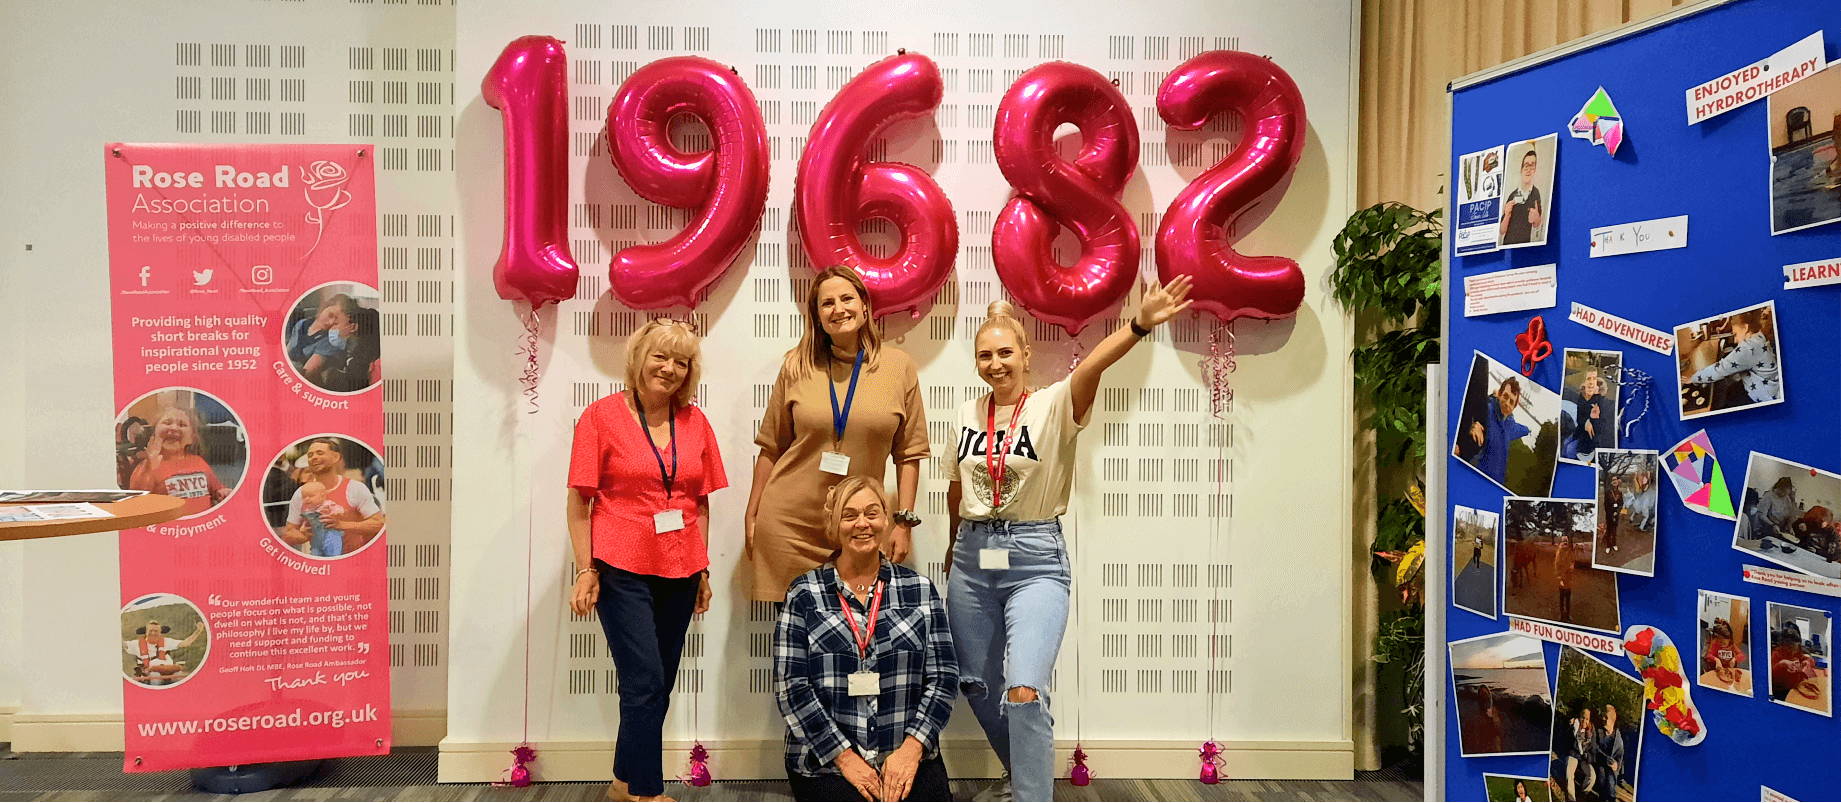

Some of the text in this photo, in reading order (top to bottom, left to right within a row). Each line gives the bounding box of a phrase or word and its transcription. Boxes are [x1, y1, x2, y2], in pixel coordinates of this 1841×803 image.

[1694, 65, 1761, 102] ENJOYED
[1695, 56, 1818, 119] HYRDROTHERAPY
[133, 165, 289, 188] Rose Road
[132, 193, 269, 213] Association
[1469, 200, 1492, 213] PACIP
[132, 221, 168, 232] Making
[180, 220, 217, 231] positive
[220, 219, 270, 229] difference
[273, 221, 284, 229] to
[133, 233, 296, 244] the lives of young disabled people
[1594, 230, 1625, 252] THAK
[1792, 263, 1841, 282] LEARN
[131, 314, 268, 329] Providing high quality
[1575, 307, 1671, 351] HAD ADVENTURES
[151, 329, 250, 342] short breaks for
[141, 345, 261, 359] inspirational young
[145, 359, 257, 375] people since 1952
[272, 361, 349, 410] Care & support
[957, 425, 1039, 467] UCLA
[177, 477, 206, 491] NYC
[146, 514, 227, 538] & enjoyment
[259, 537, 331, 576] Get involved!
[241, 596, 288, 607] wonderful
[289, 595, 312, 604] team
[314, 594, 331, 603] and
[332, 594, 361, 604] young
[210, 608, 241, 620] people
[243, 608, 267, 617] focus
[282, 606, 305, 615] what
[307, 605, 314, 613] is
[316, 603, 355, 615] possible,
[356, 603, 372, 611] not
[214, 619, 239, 629] dwell
[254, 617, 278, 626] what
[279, 617, 287, 625] is
[288, 616, 306, 626] not,
[308, 614, 325, 623] and
[327, 613, 352, 622] that's
[354, 612, 369, 621] the
[216, 623, 368, 641] philosophy I live my life by, but we
[1514, 619, 1614, 652] HAD FUN OUTDOORS
[229, 640, 252, 649] need
[254, 637, 289, 649] support
[290, 636, 307, 645] and
[309, 634, 343, 646] funding
[229, 648, 269, 659] continue
[270, 647, 287, 656] this
[289, 645, 328, 655] excellent
[218, 666, 239, 674] Geoff
[266, 663, 286, 671] MBE,
[286, 662, 304, 670] Rose
[304, 660, 323, 668] Road
[323, 658, 367, 668] Ambassador
[264, 670, 370, 691] Thank you
[137, 703, 378, 737] www.roseroad.org.uk
